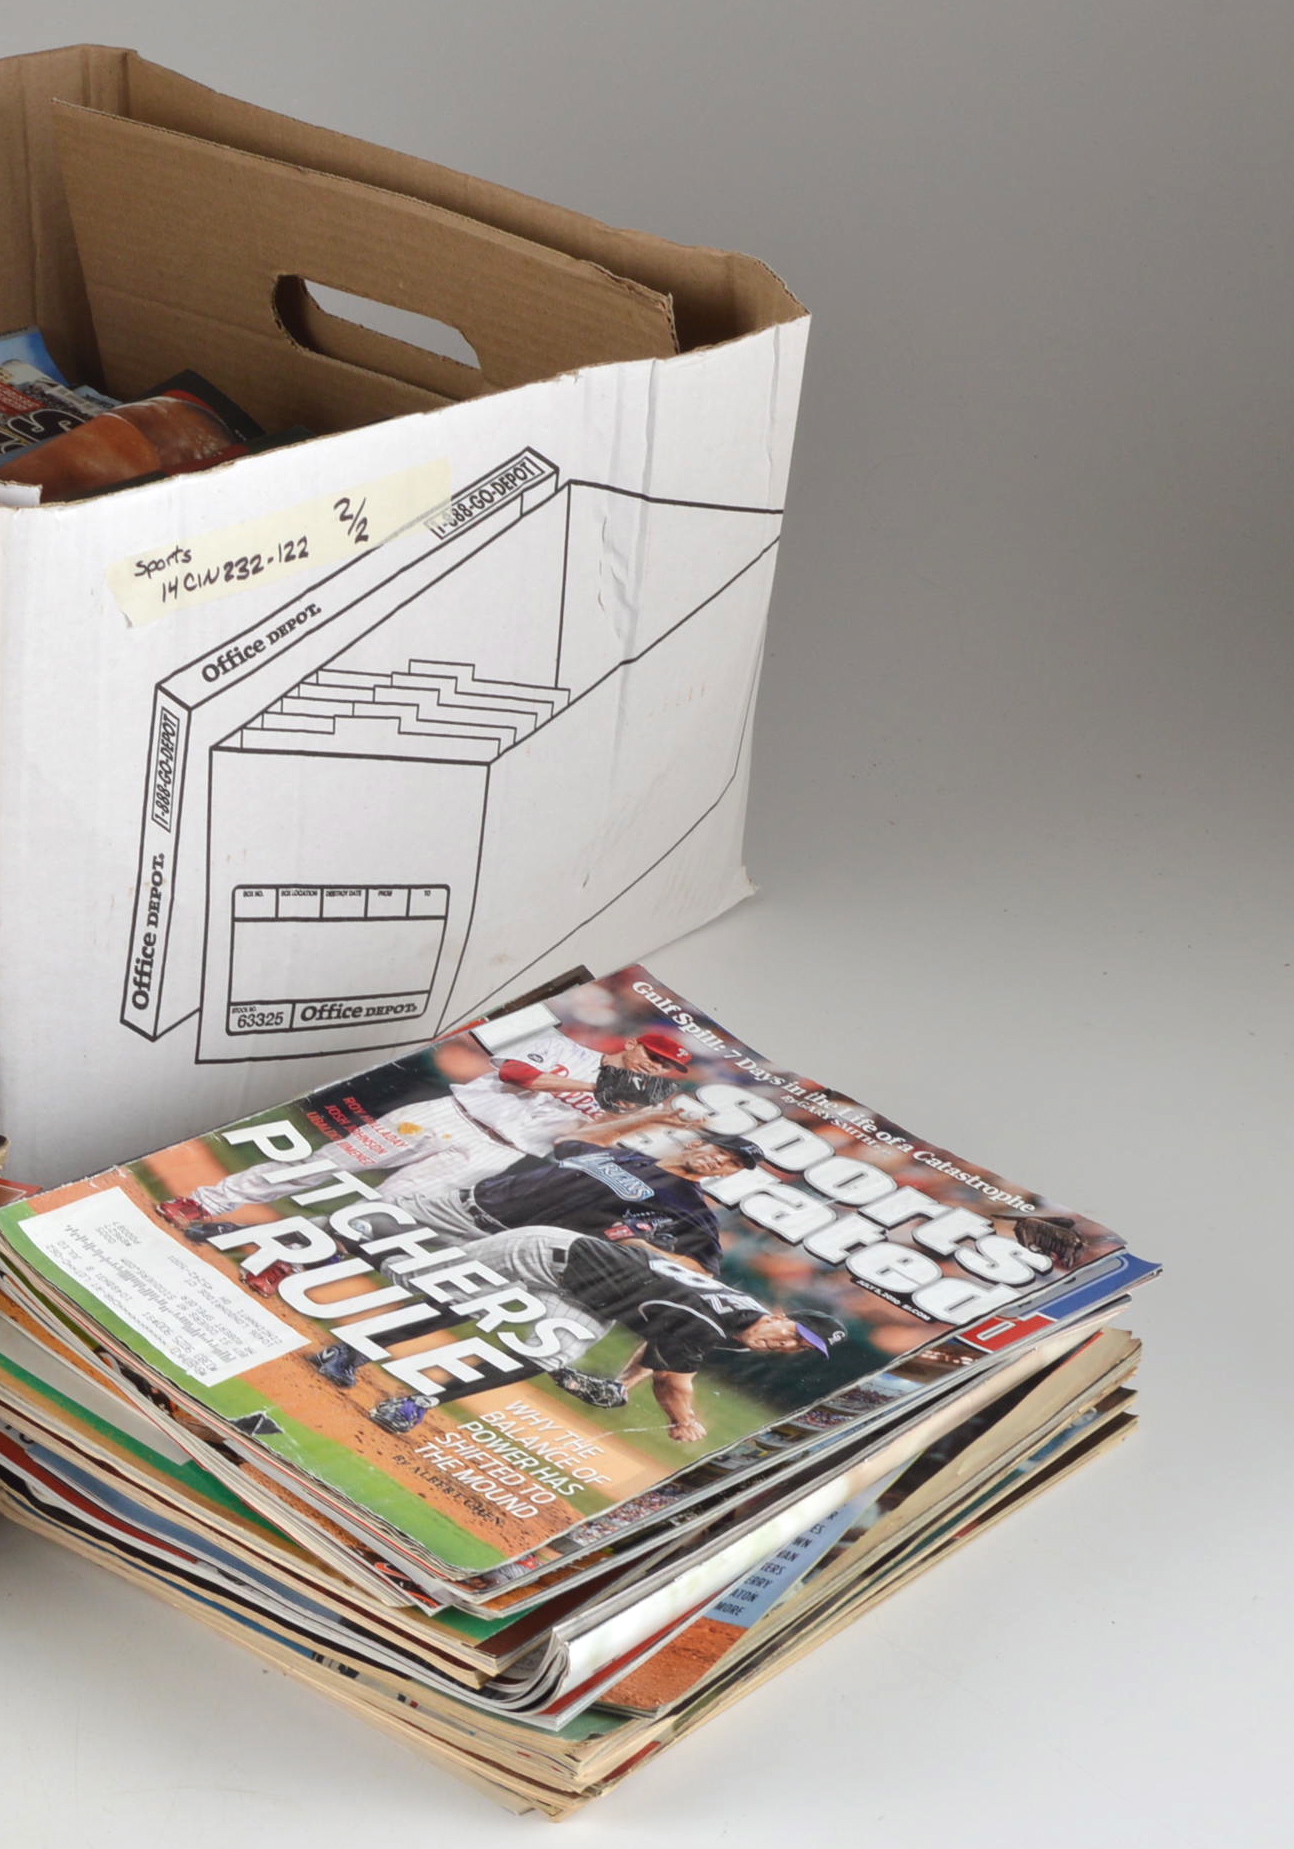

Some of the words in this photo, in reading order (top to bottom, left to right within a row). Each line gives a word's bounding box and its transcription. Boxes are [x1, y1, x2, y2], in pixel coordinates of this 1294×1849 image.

[133, 545, 192, 579] Sports
[201, 635, 268, 685] Office
[153, 713, 180, 824] 1-888-GO-DEPOT
[131, 933, 157, 1011] Office
[237, 1011, 284, 1029] 63325
[300, 1003, 363, 1022] Office
[343, 1096, 367, 1114] ROY
[361, 1114, 410, 1148] HALLADAY
[632, 981, 681, 1016] Gulf
[673, 1011, 726, 1052] Spill:
[723, 1048, 743, 1060] 7
[734, 1057, 787, 1087] Days
[781, 1081, 808, 1097] in
[803, 1091, 839, 1110] the
[837, 1106, 878, 1134] Life
[875, 1128, 900, 1149] of
[897, 1140, 915, 1154] a
[912, 1147, 1036, 1214] Catastrophe
[306, 1111, 346, 1141] UBALDO
[323, 1105, 352, 1126] JOSH
[346, 1124, 389, 1155] JOHNSON
[796, 1100, 832, 1121] GARY
[830, 1117, 877, 1149] SMITH
[672, 1083, 1054, 1288] Sports
[221, 1119, 598, 1360] PITCHERS
[206, 1215, 526, 1397] RULE
[901, 1303, 931, 1322] SI.COM
[479, 1410, 581, 1470] BALANCE
[572, 1466, 612, 1487] OF
[504, 1399, 564, 1431] WHY
[555, 1429, 605, 1460] THE
[412, 1466, 464, 1500] ALBERT
[414, 1441, 464, 1472] THE
[452, 1468, 539, 1520] MOUND
[435, 1431, 525, 1487] SHIFTED
[520, 1482, 557, 1505] TO
[457, 1421, 540, 1472] POWER
[531, 1465, 585, 1497] HAS
[730, 1588, 760, 1603] ATON
[744, 1575, 774, 1589] ERRY
